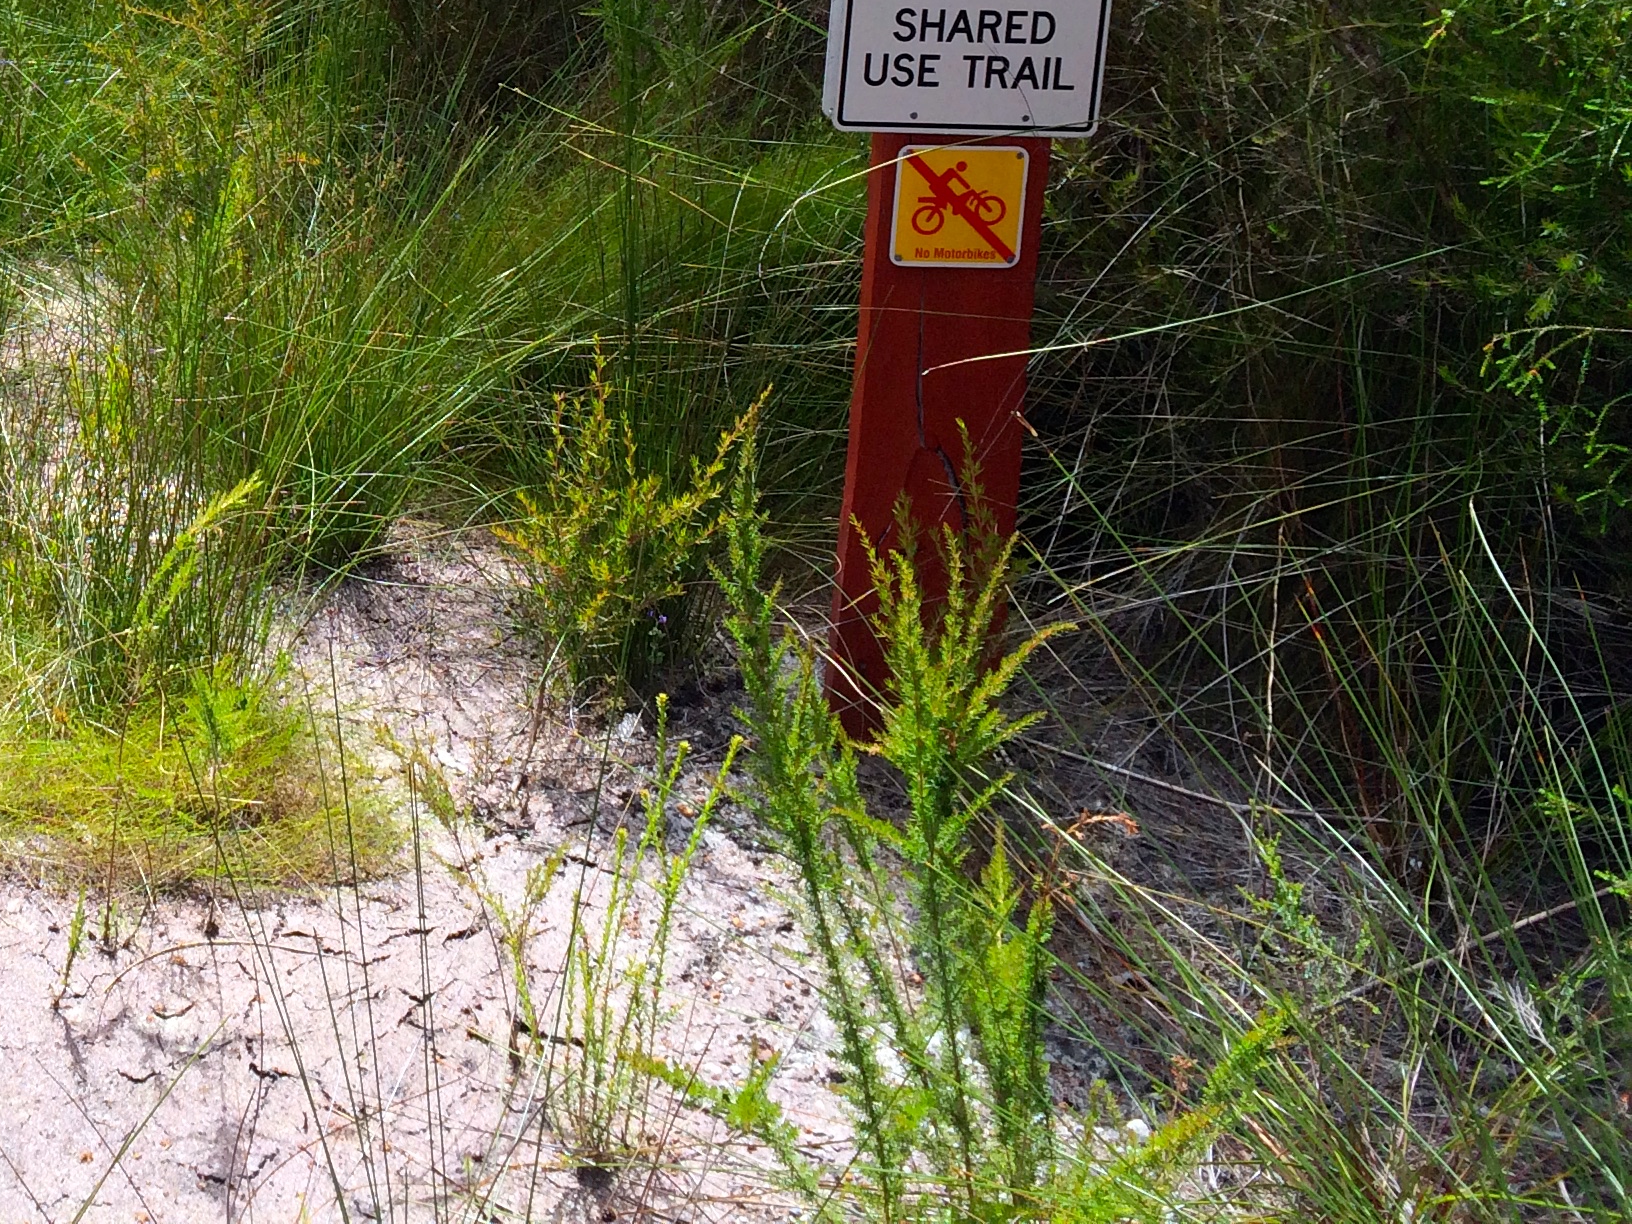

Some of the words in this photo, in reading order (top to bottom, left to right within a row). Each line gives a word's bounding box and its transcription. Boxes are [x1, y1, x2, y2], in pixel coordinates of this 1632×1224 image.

[892, 7, 1056, 45] SHARED
[863, 52, 941, 88] USE
[962, 55, 1075, 91] TRAIL
[914, 247, 930, 259] No
[933, 247, 997, 260] Motorbikes
